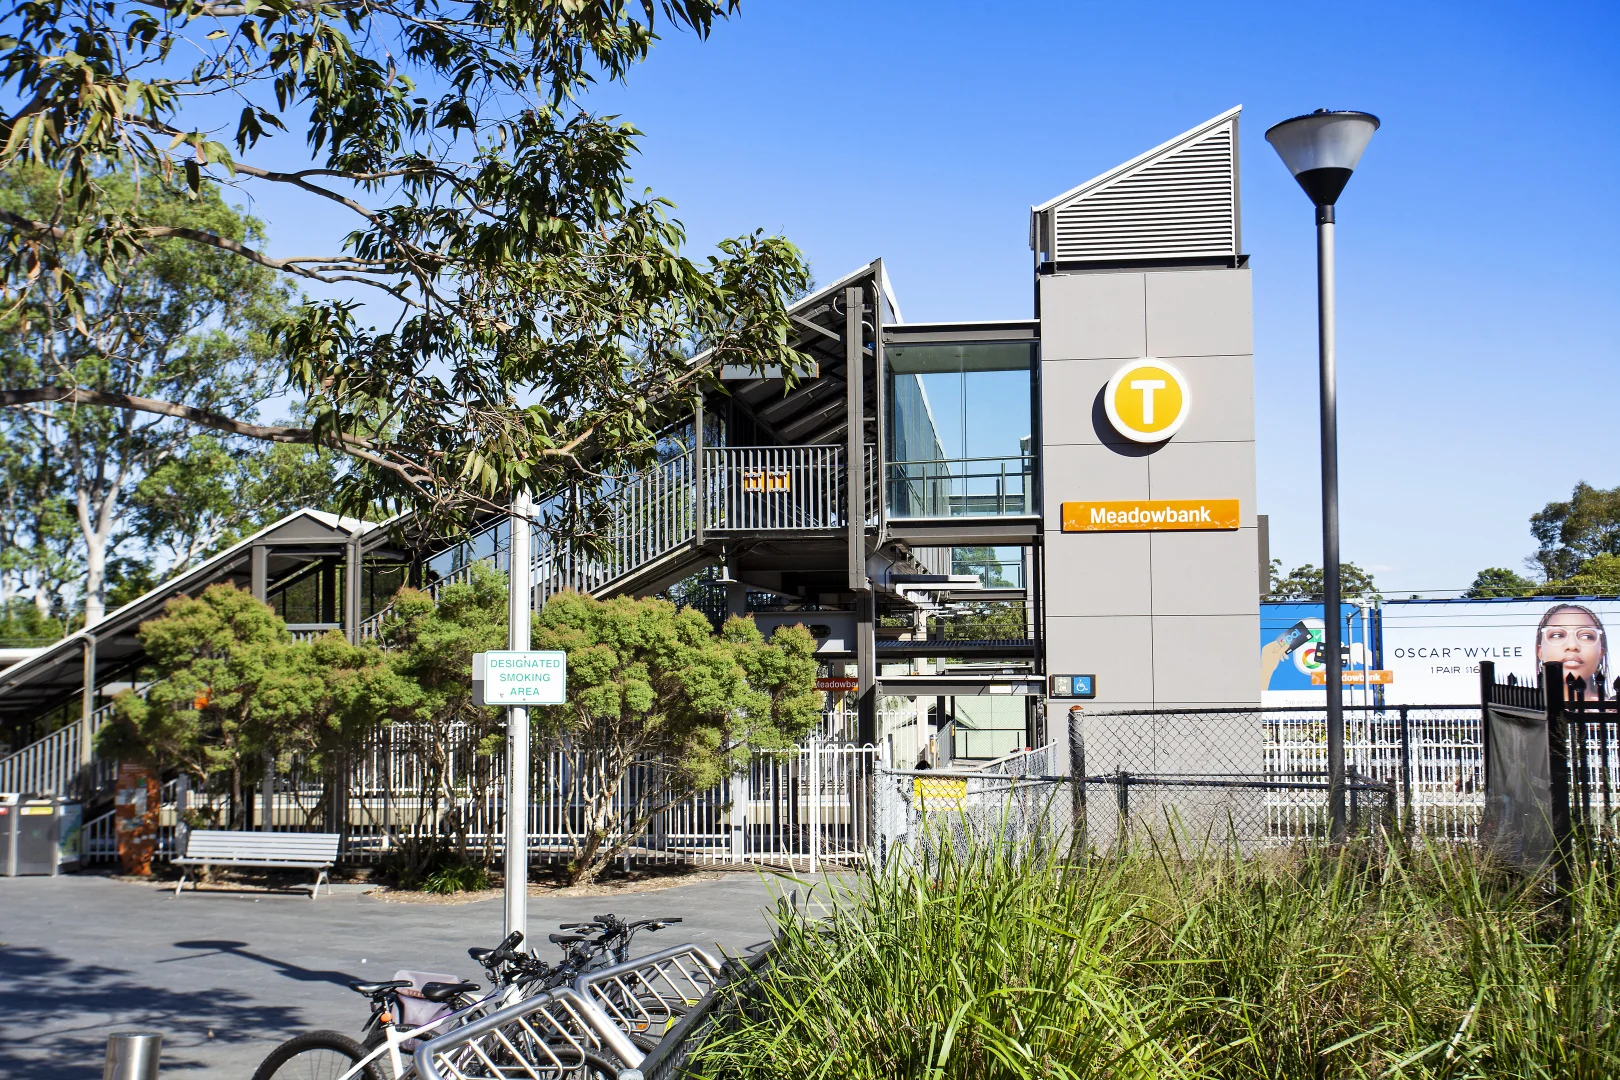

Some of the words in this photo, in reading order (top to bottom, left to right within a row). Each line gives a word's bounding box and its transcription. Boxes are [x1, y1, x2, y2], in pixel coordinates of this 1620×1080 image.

[1130, 379, 1166, 425] T
[1090, 505, 1211, 524] Meadowbank
[1394, 647, 1451, 658] OSCAR
[1464, 646, 1523, 658] WYLEE
[490, 659, 561, 668] DESIGNATED
[1436, 666, 1461, 674] PAIR
[1465, 665, 1481, 674] $16
[499, 673, 551, 682] SMOKING
[509, 687, 540, 696] AREA
